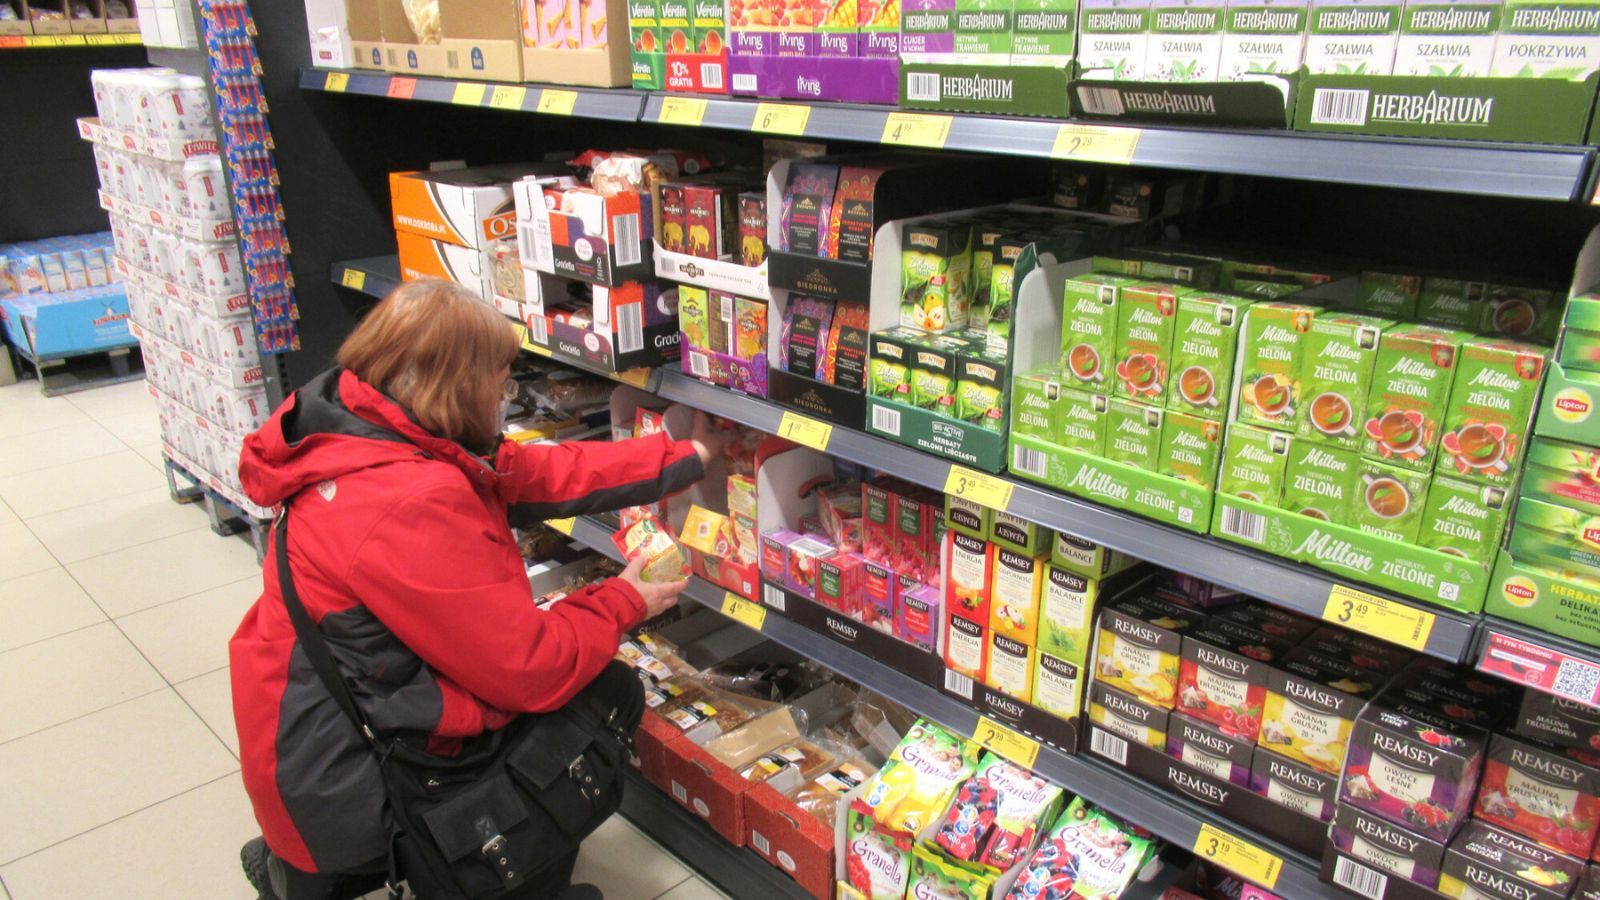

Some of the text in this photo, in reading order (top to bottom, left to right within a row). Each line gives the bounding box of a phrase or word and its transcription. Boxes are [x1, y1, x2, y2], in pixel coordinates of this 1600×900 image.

[631, 3, 655, 18] Verdin
[662, 3, 687, 18] Verdin
[696, 3, 723, 18] Verdin
[1410, 7, 1492, 31] HERBARIUM
[1512, 6, 1600, 31] HERBARIUM
[906, 13, 949, 30] HERBARIUM
[959, 12, 1005, 30] HERBARIUM
[1017, 12, 1068, 30] HERBARIUM
[1088, 11, 1142, 30] HERBARIUM
[1157, 10, 1216, 30] HERBARIUM
[1233, 10, 1299, 30] HERBARIUM
[1318, 9, 1391, 31] HERBARIUM
[903, 36, 926, 45] CUKIER
[956, 44, 988, 53] TRAWIENIE
[1014, 44, 1050, 54] TRAWIENIE
[1093, 41, 1131, 52] SZAŁWIA
[1162, 41, 1202, 53] SZAŁWIA
[1239, 42, 1283, 55] SZAŁWIA
[1324, 44, 1374, 56] SZAŁWIA
[1417, 44, 1471, 57] SZAŁWIA
[1509, 44, 1587, 59] POKRZYWA
[671, 63, 689, 77] 10%
[669, 77, 693, 88] GRATIS
[943, 74, 1013, 100] HERBARIUM
[1123, 90, 1217, 114] HERBARIUM
[1371, 90, 1494, 124] HERBARIUM
[796, 279, 838, 295] BIEDRONKA
[1072, 298, 1105, 315] Milton
[1129, 307, 1163, 326] Milton
[1070, 320, 1102, 336] ZIELONA
[1129, 328, 1158, 342] ZIELONA
[1185, 318, 1222, 336] Milton
[1258, 324, 1297, 343] Milton
[1182, 341, 1220, 359] ZIELONA
[1257, 347, 1292, 361] ZIELONA
[1318, 340, 1361, 362] Milton
[1314, 365, 1358, 385] ZIELONA
[1388, 357, 1437, 379] Milton
[1468, 367, 1521, 391] Milton
[1387, 380, 1428, 398] ZIELONA
[794, 397, 833, 415] BIEDRONKA
[1021, 392, 1050, 410] Milton
[1468, 392, 1511, 410] ZIELONA
[1557, 399, 1586, 413] Lipton
[1019, 412, 1049, 429] ZIELONA
[1067, 403, 1098, 421] Milton
[1064, 424, 1096, 441] ZIELONA
[1117, 418, 1150, 436] Milton
[917, 439, 944, 452] ZIELONE
[933, 436, 962, 449] HERBATY
[1114, 439, 1149, 456] ZIELONA
[1171, 430, 1208, 450] Milton
[1171, 449, 1202, 466] ZIELONA
[1235, 443, 1275, 464] Milton
[1300, 447, 1347, 472] Milton
[1068, 463, 1130, 500] Milton
[1232, 466, 1270, 485] ZIELONA
[867, 487, 888, 500] REMSEY
[956, 477, 966, 495] 3
[1293, 475, 1343, 500] ZIELONA
[899, 499, 920, 511] REMSEY
[1135, 490, 1176, 513] ZIELONE
[1440, 495, 1489, 520] Milton
[952, 511, 978, 528] REMSEY
[999, 527, 1025, 544] REMSEY
[1433, 520, 1481, 542] ZIELONA
[956, 536, 982, 550] REMSEY
[1292, 529, 1374, 575] Milton
[955, 551, 982, 565] ENERGIA
[1001, 552, 1031, 569] REMSEY
[1060, 545, 1093, 564] BALANCE
[820, 563, 840, 575] REMSEY
[867, 565, 887, 578] REMSEY
[1381, 561, 1436, 589] ZIELONE
[1052, 570, 1085, 590] REMSEY
[1050, 586, 1084, 604] BALANCE
[1507, 585, 1533, 598] Lipton
[729, 599, 737, 615] 4
[905, 597, 929, 611] REMSEY
[1338, 600, 1353, 622] 3
[1560, 598, 1600, 616] DELIKA
[827, 617, 858, 639] REMSEY
[953, 616, 980, 634] REMSEY
[1115, 618, 1162, 645] REMSEY
[952, 632, 979, 648] ENERGIA
[995, 637, 1025, 655] REMSEY
[1120, 652, 1151, 668] GRUSZKA
[1123, 646, 1151, 659] ANANAS
[1197, 648, 1249, 675] REMSEY
[1043, 656, 1074, 675] REMSEY
[1041, 672, 1073, 690] BALANCE
[1207, 676, 1236, 690] MALINA
[1199, 680, 1244, 701] TRUSKAWKA
[1285, 680, 1345, 710] REMSEY
[985, 692, 1024, 717] REMSEY
[1105, 693, 1150, 722] REMSEY
[1290, 717, 1328, 736] GRUSZKA
[1294, 709, 1328, 728] ANANAS
[1381, 712, 1408, 725] OWOCE
[1536, 715, 1569, 729] MALINA
[1113, 720, 1138, 736] ANANAS
[1525, 718, 1577, 739] TRUSKAWKA
[984, 729, 995, 747] 2
[1183, 726, 1234, 755] REMSEY
[1373, 732, 1440, 767] REMSEY
[1384, 765, 1418, 785] OWOCE
[1511, 749, 1584, 783] REMSEY
[985, 764, 1047, 805] Granella
[1168, 766, 1229, 803] REMSEY
[1270, 761, 1326, 792] REMSEY
[1386, 775, 1412, 790] LEŚNE
[1280, 790, 1310, 807] OWOCE
[1521, 781, 1560, 800] MALINA
[1355, 817, 1419, 852] REMSEY
[1059, 825, 1127, 875] Granella
[1205, 837, 1219, 856] 3
[1470, 842, 1502, 857] ANANAS
[1487, 831, 1554, 862] REMSEY
[852, 839, 902, 885] Granella
[1366, 848, 1399, 868] OWOCE
[1465, 865, 1537, 900] REMSEY
